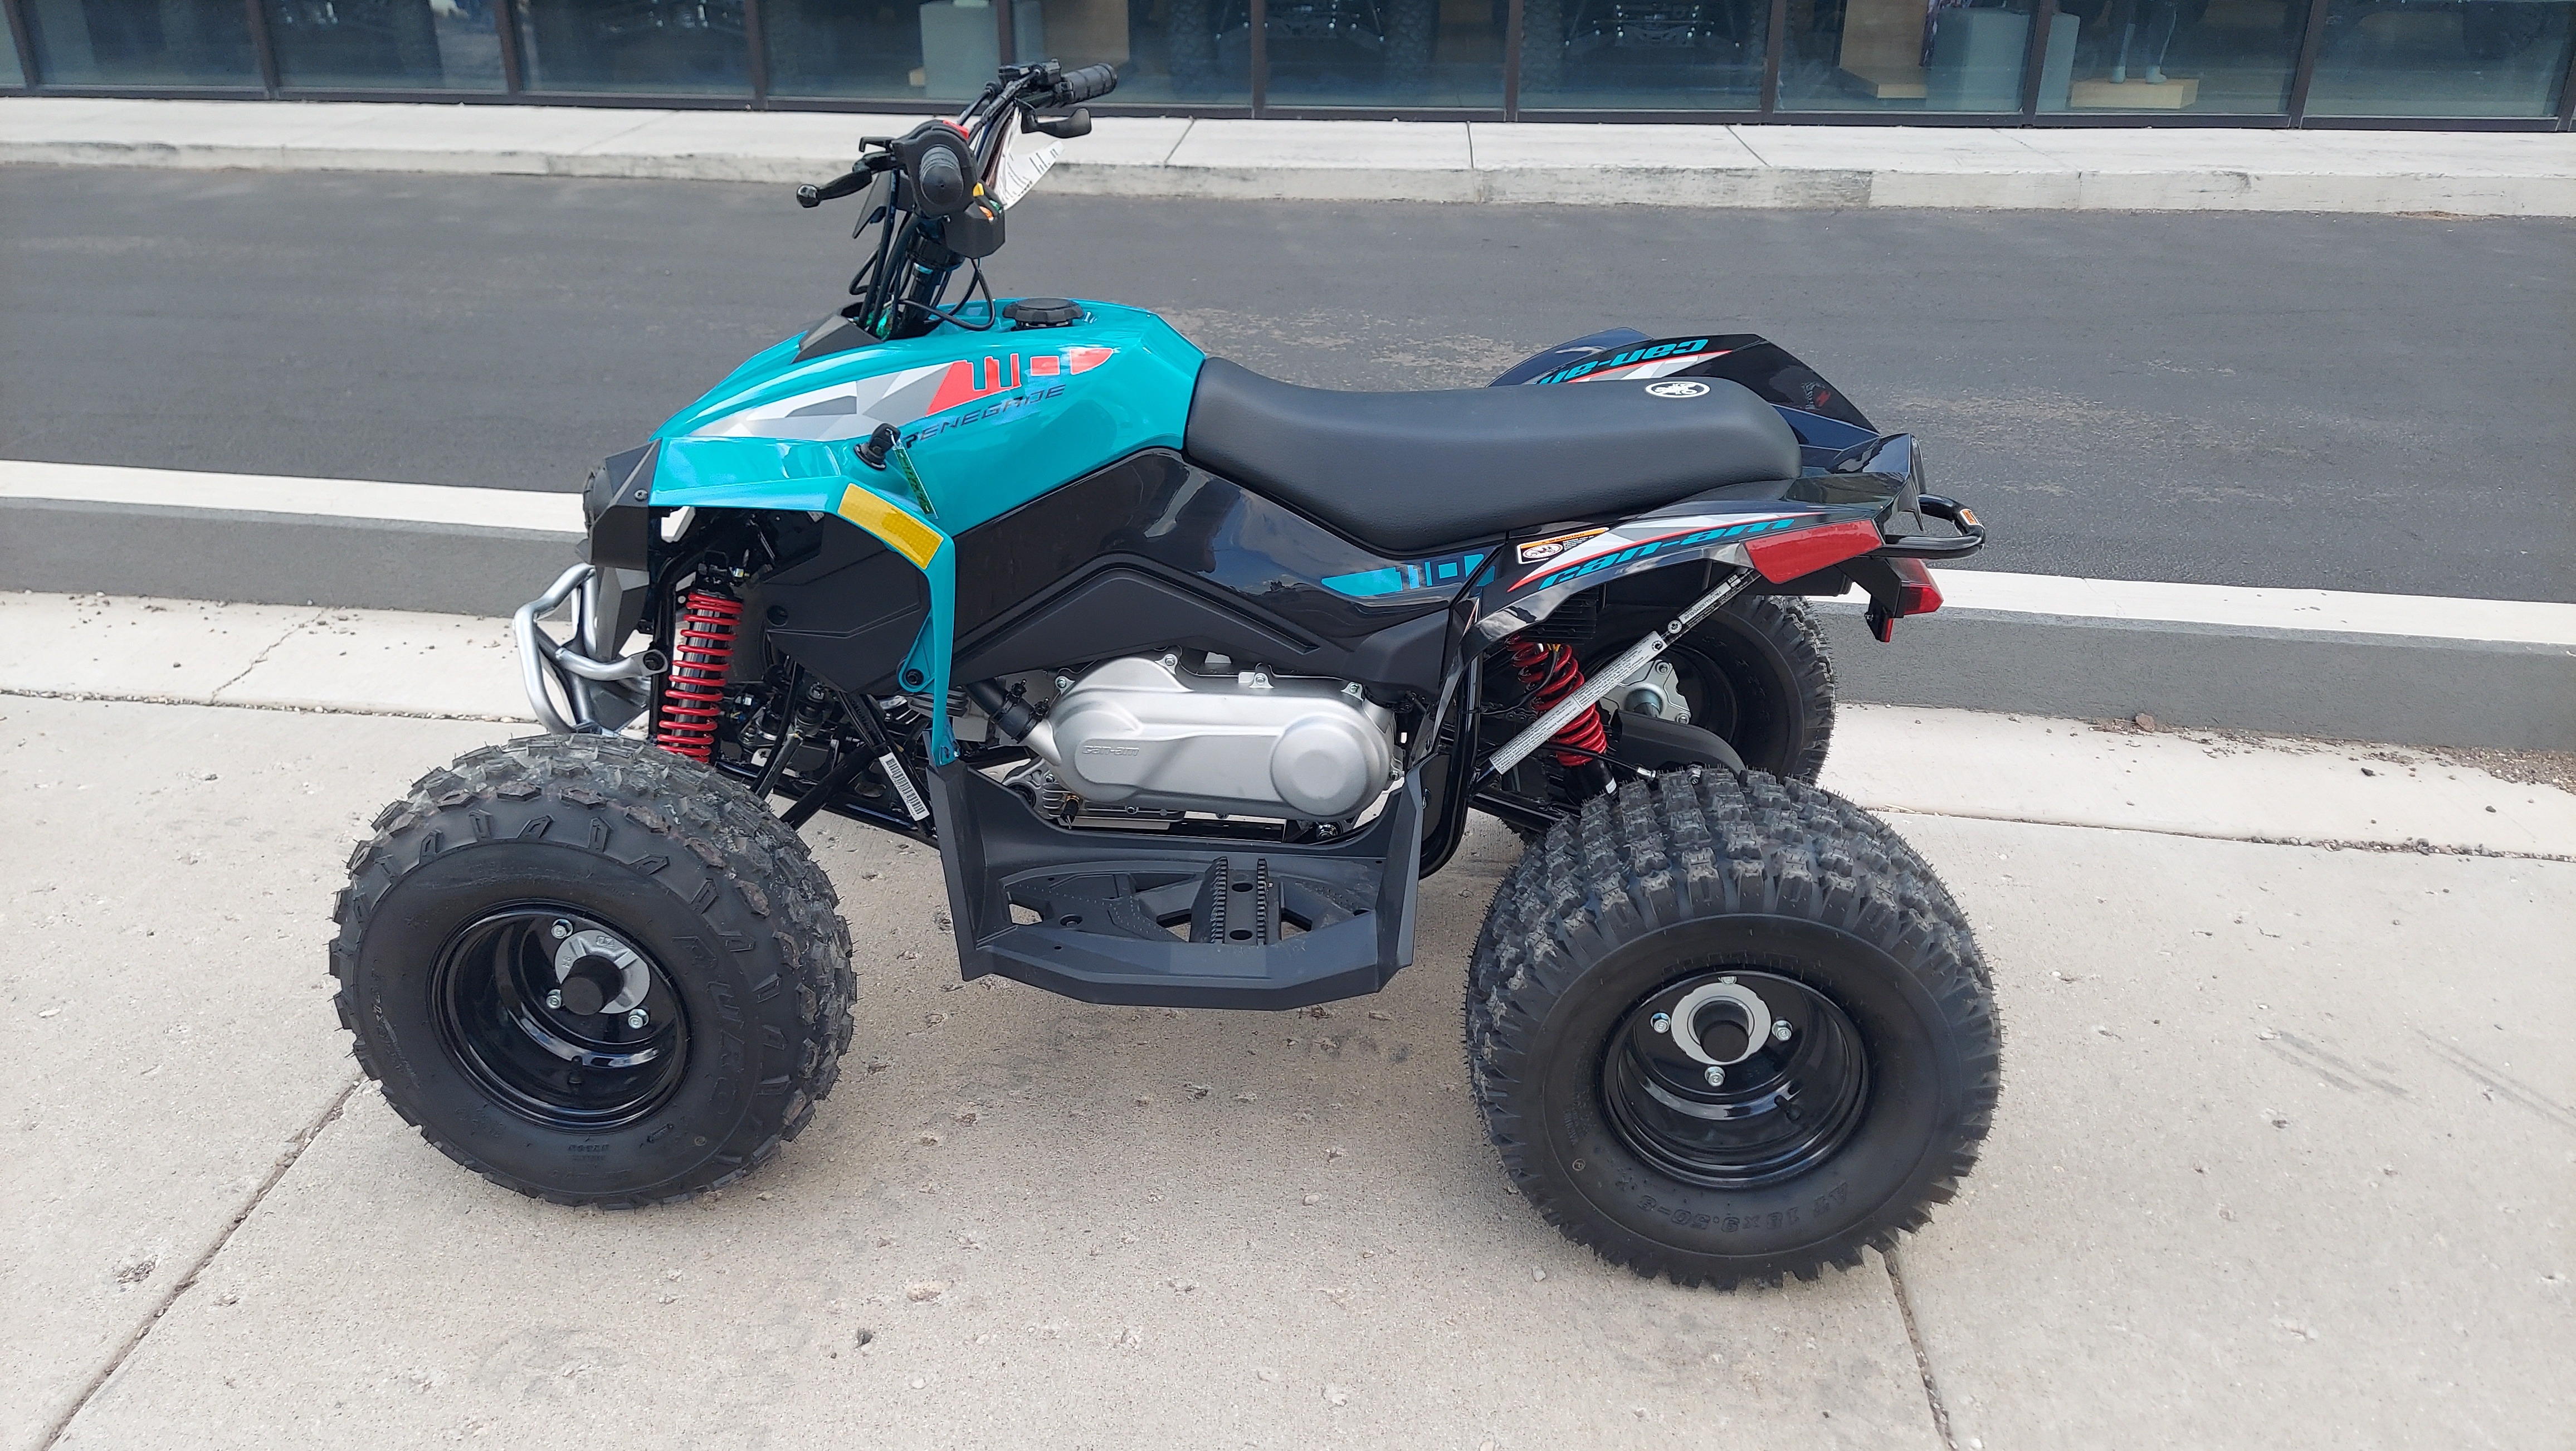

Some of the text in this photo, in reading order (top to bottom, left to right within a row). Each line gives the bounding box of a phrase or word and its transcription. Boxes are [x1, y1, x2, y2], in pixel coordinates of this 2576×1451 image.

[902, 383, 1066, 449] RENEGADE
[1538, 519, 1795, 591] can-am
[1082, 745, 1139, 756] can-am
